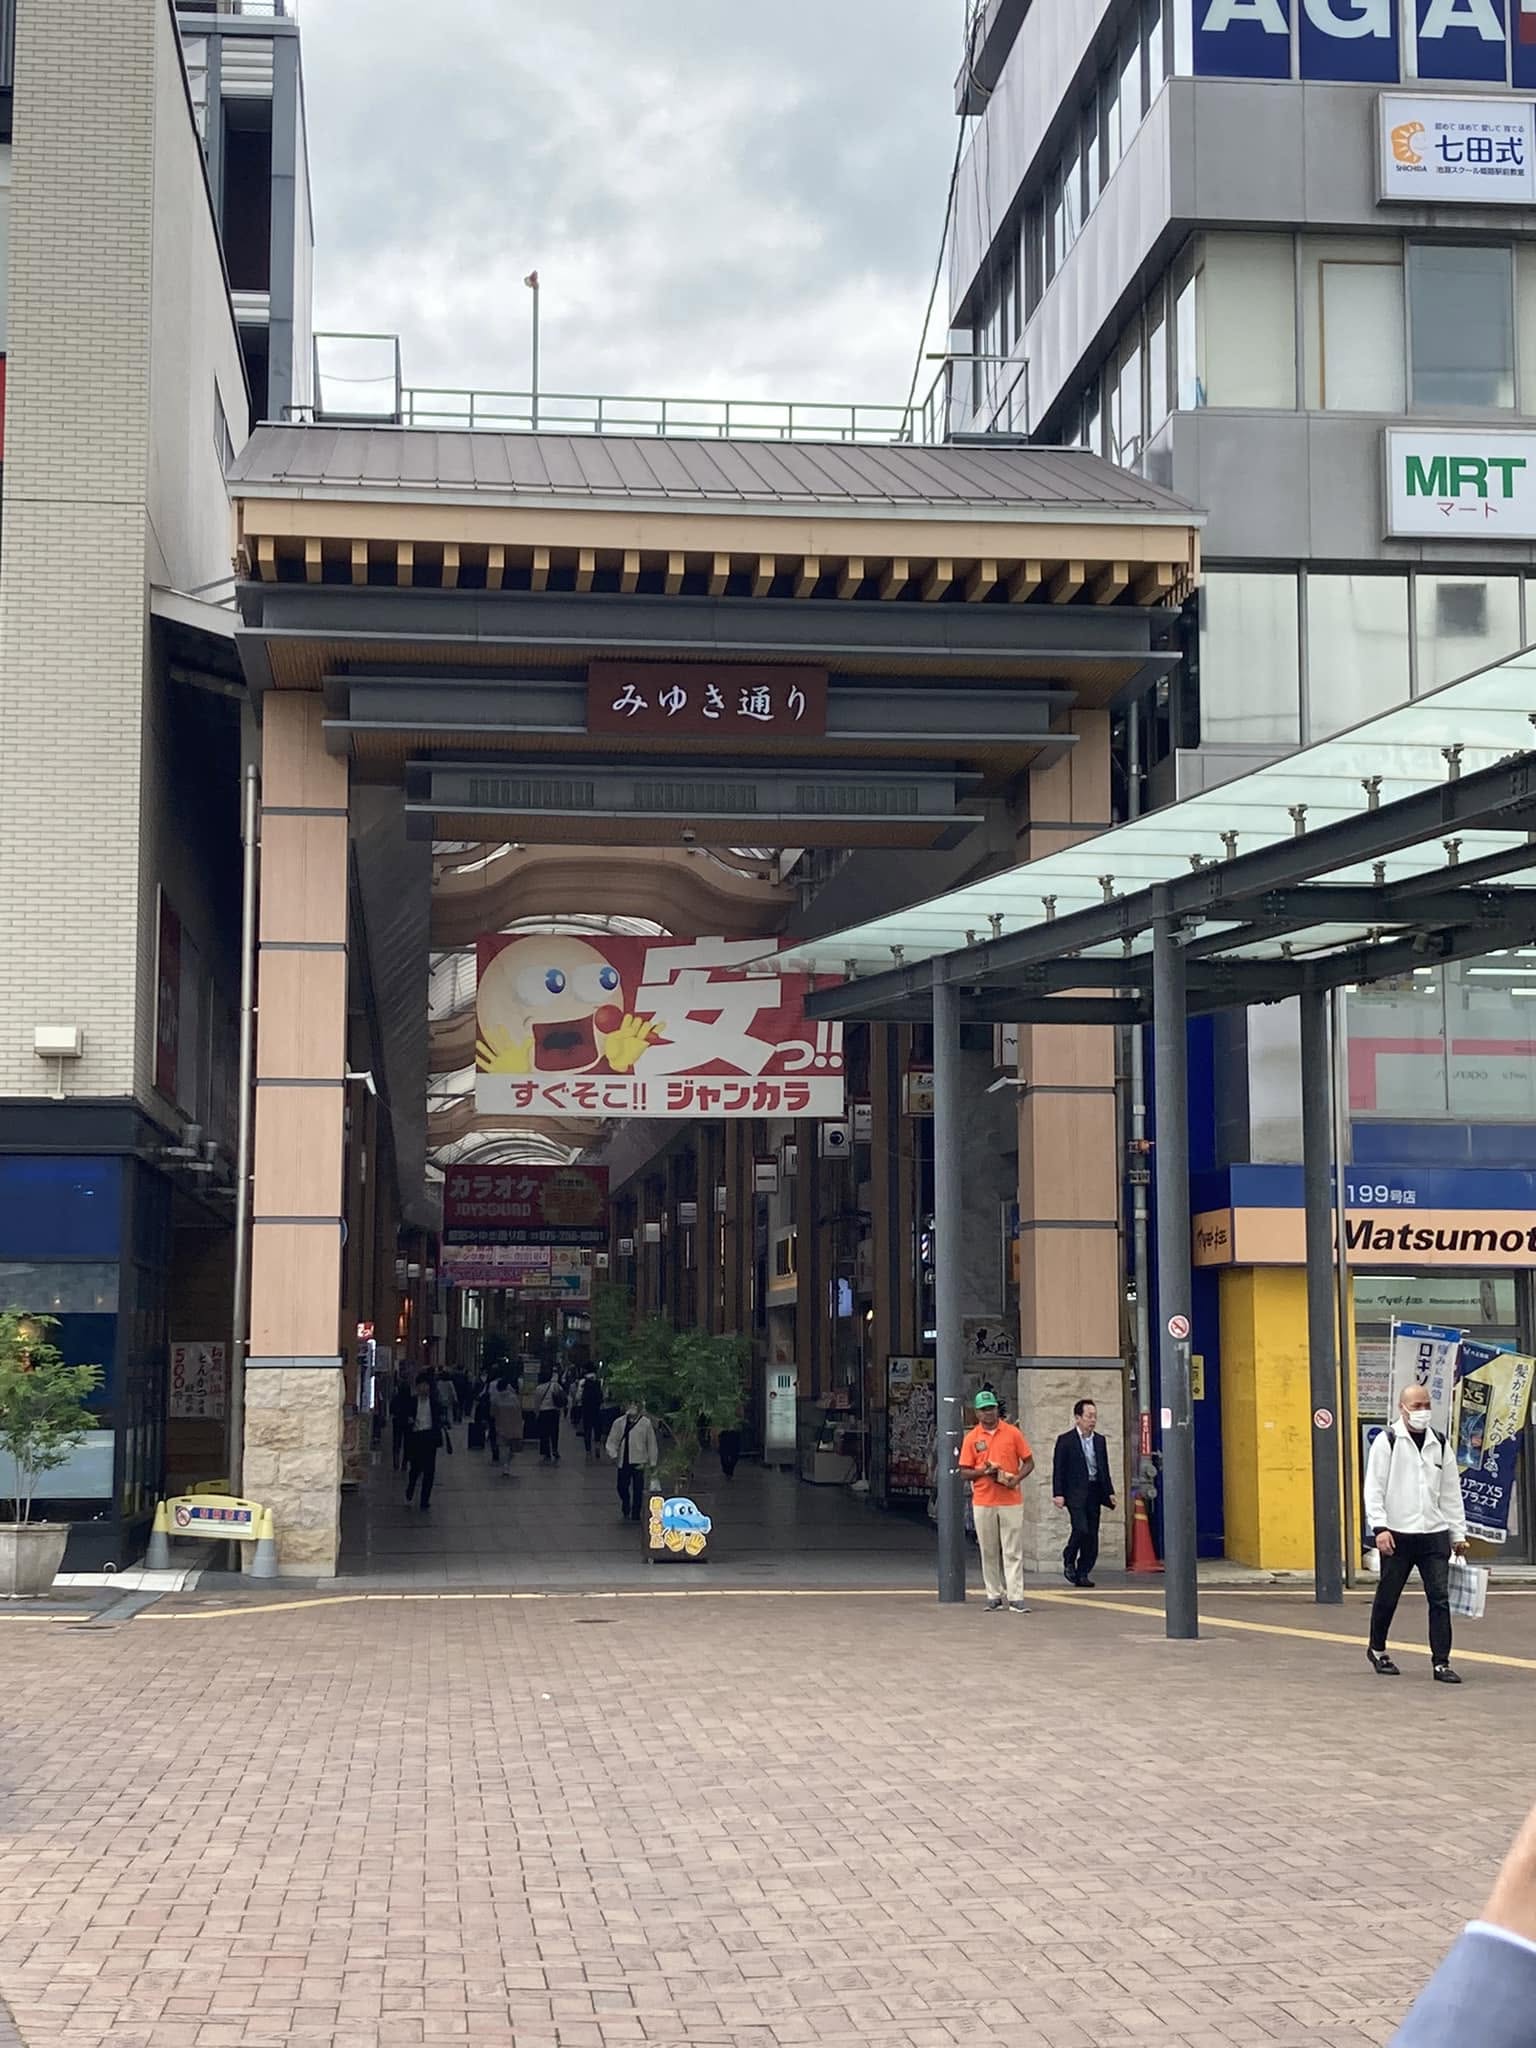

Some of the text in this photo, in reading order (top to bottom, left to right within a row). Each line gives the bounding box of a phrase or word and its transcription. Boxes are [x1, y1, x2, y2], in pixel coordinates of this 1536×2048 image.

[1435, 134, 1524, 165] 七田式
[1406, 456, 1526, 498] MRT
[1437, 502, 1498, 518] マート
[612, 683, 807, 721] みゆき通り
[511, 1080, 810, 1111] すぐそこ!! ジャンカラ
[451, 1175, 539, 1199] カラオケ
